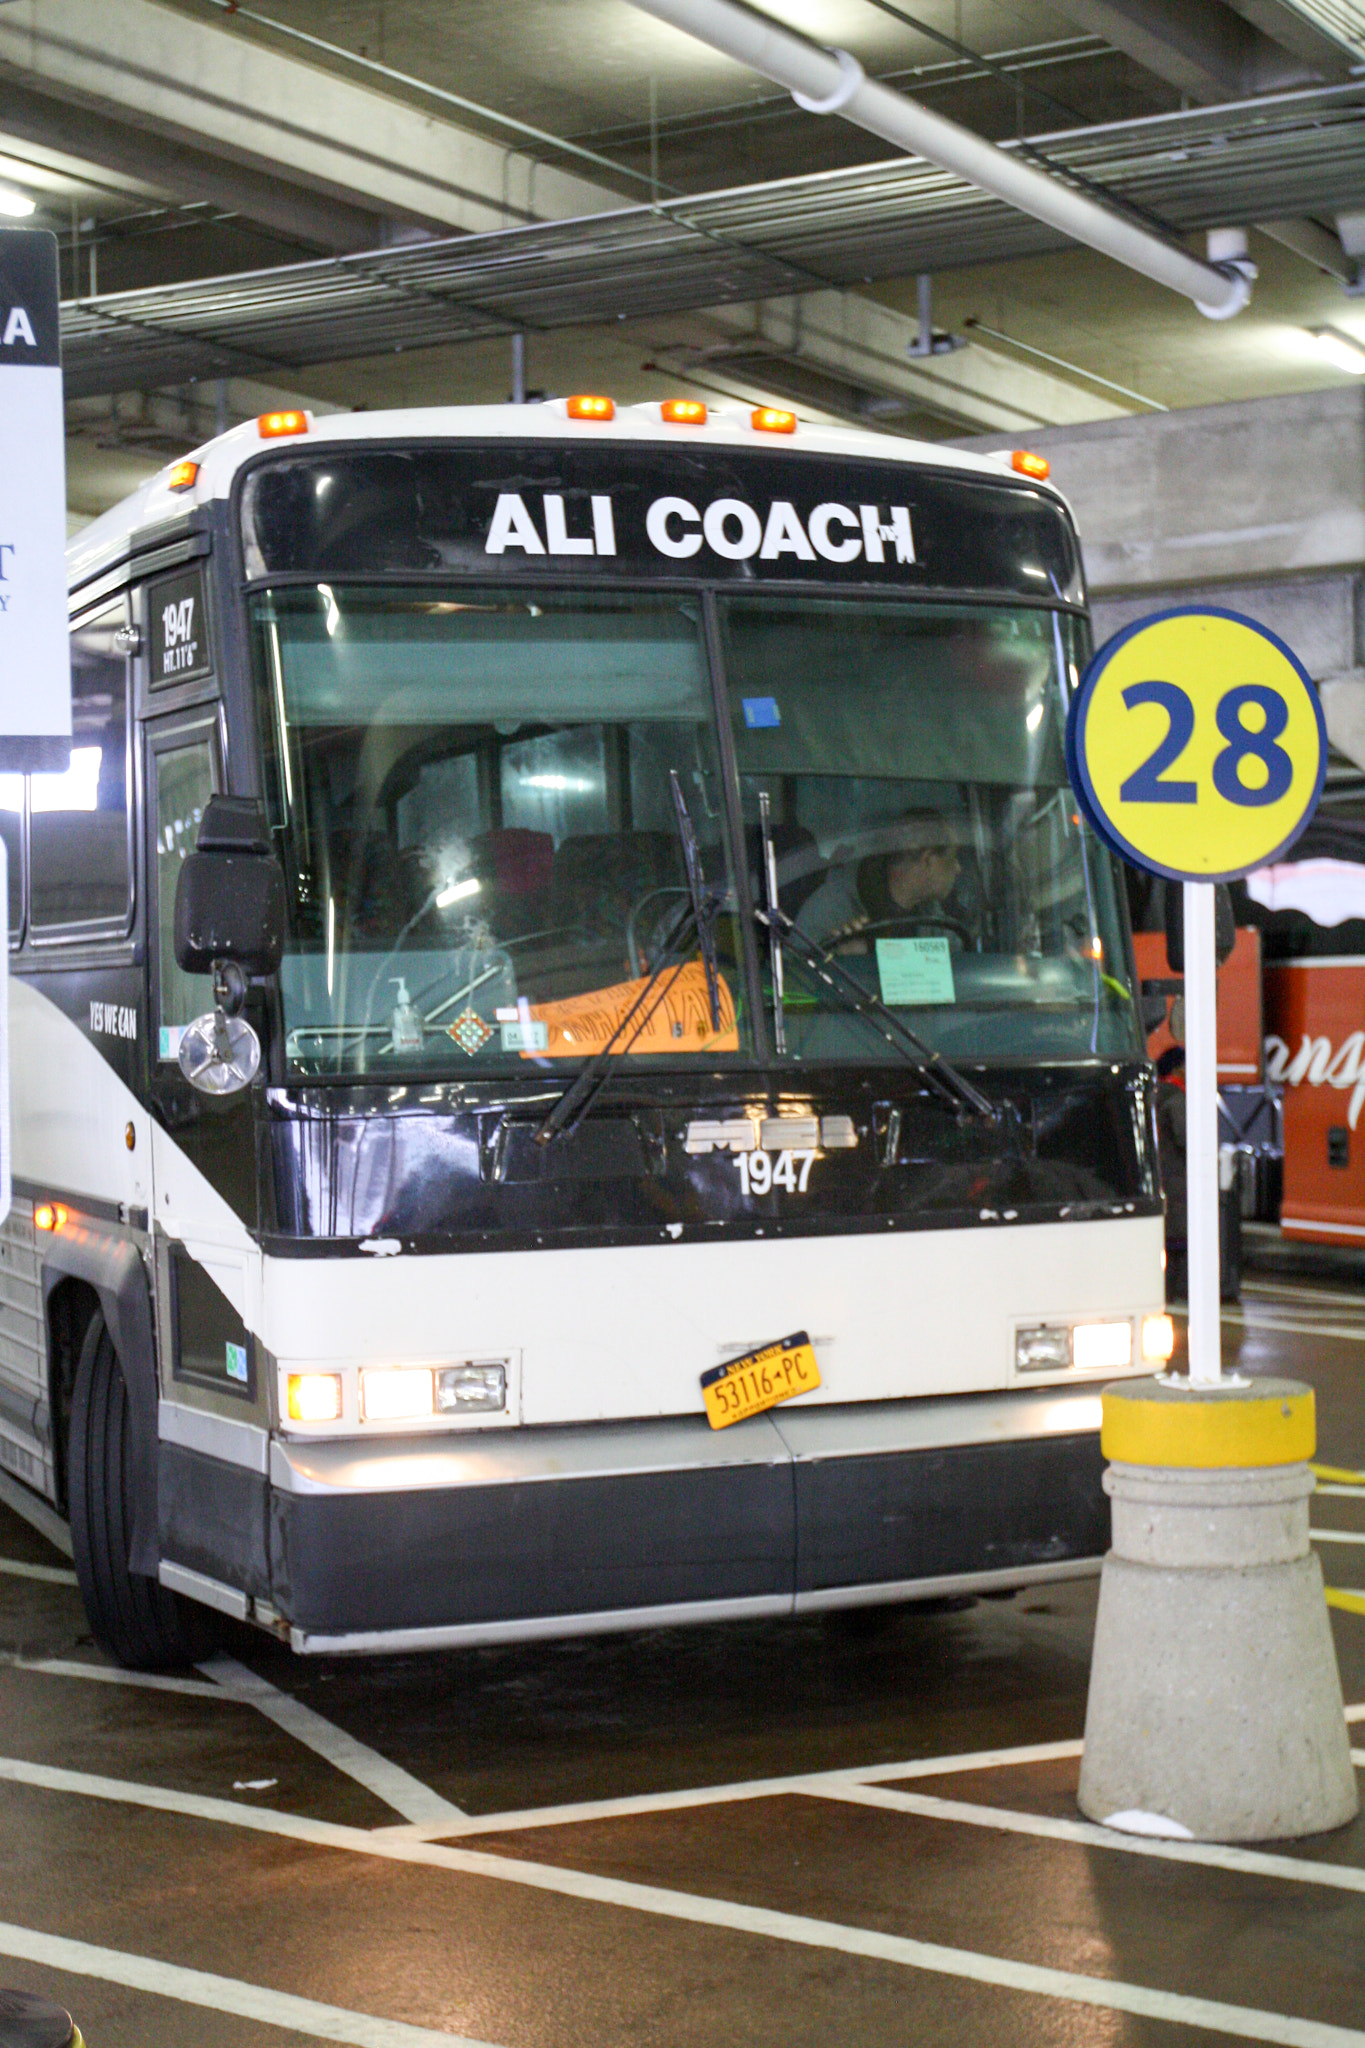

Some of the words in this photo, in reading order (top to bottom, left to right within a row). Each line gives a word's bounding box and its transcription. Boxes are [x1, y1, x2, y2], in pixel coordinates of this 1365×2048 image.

[484, 493, 617, 556] ALI
[645, 496, 917, 564] COACH
[162, 597, 195, 648] 1947
[1119, 680, 1293, 807] 28
[104, 1003, 118, 1037] WE
[118, 1005, 137, 1040] CAN
[732, 1149, 815, 1196] 1947
